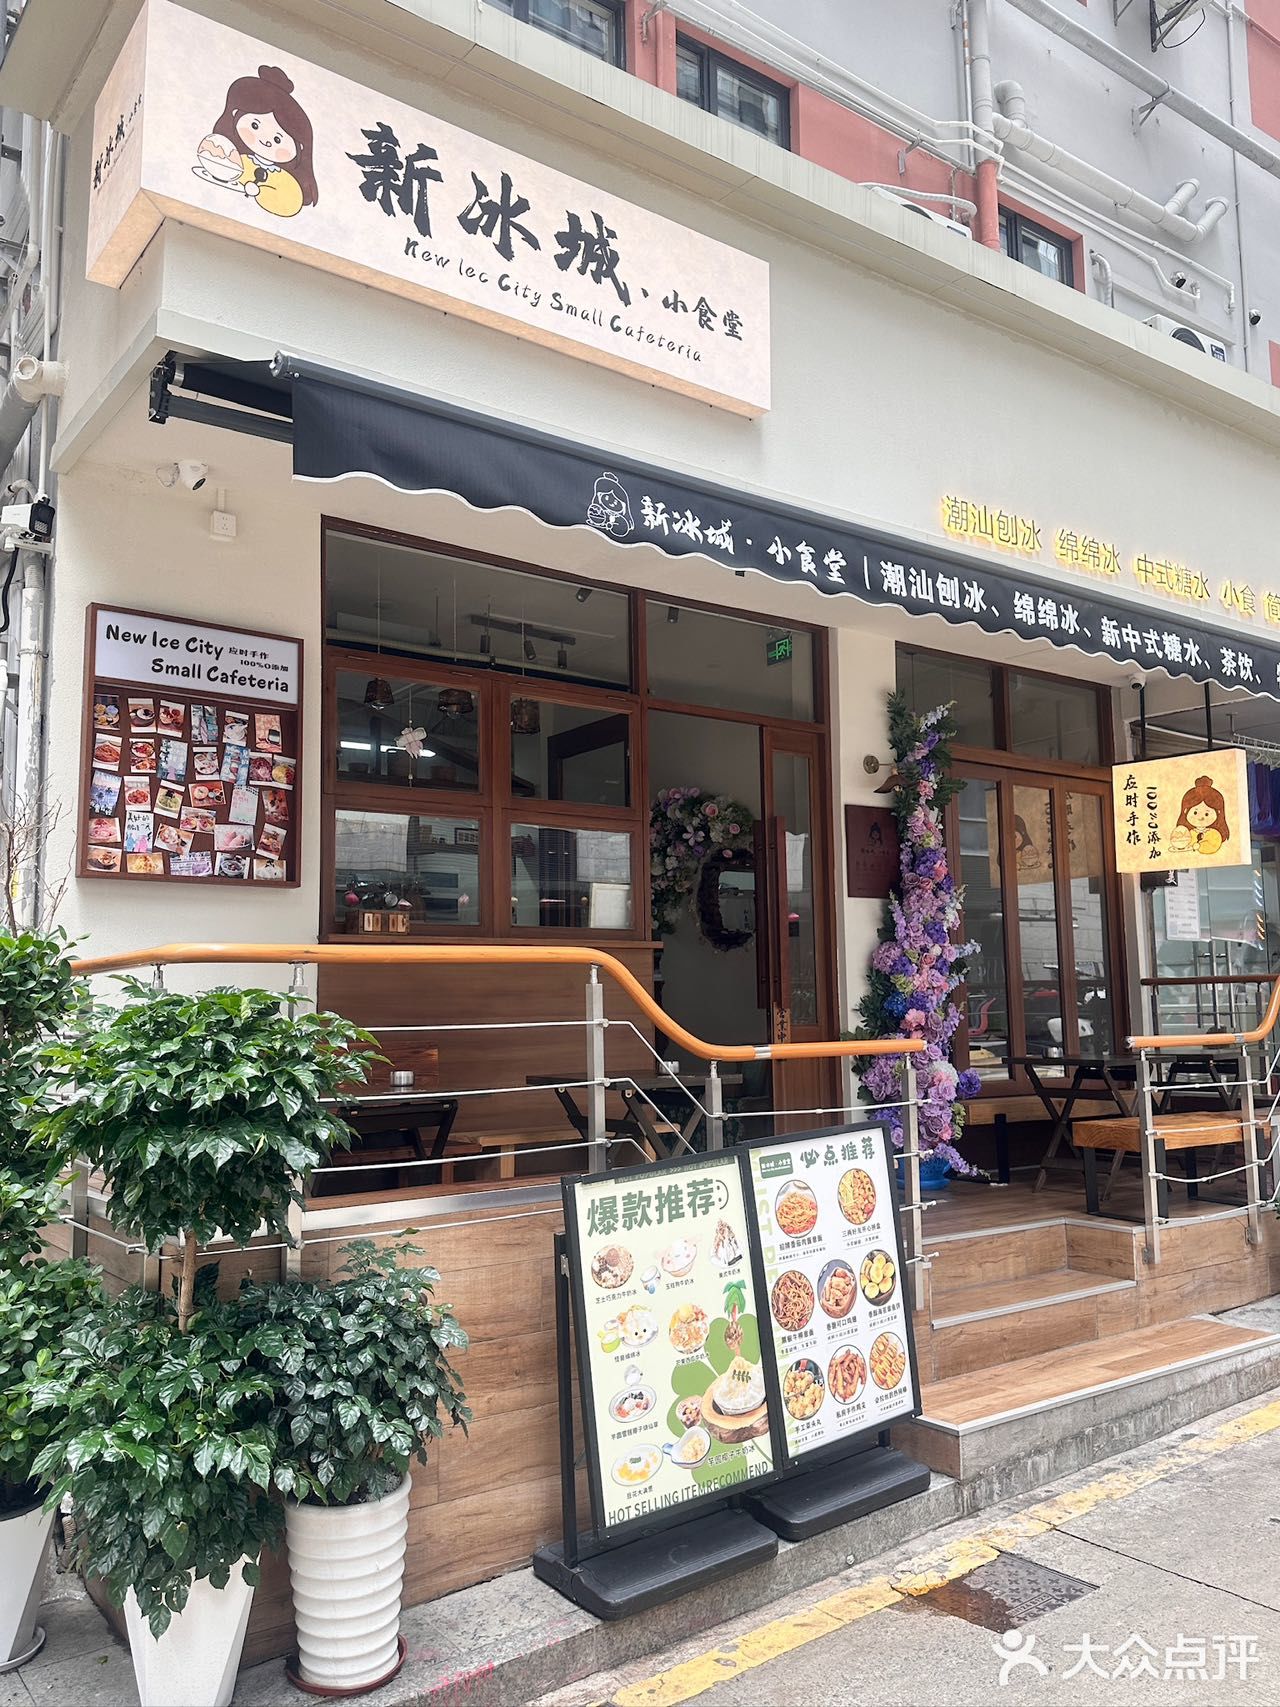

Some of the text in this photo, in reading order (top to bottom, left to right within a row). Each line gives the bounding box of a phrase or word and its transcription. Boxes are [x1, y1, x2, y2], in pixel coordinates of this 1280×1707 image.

[498, 273, 542, 307] City
[550, 292, 602, 327] Small
[609, 315, 702, 362] Cafeteria
[943, 496, 1042, 553] 潮汕刨冰
[1056, 528, 1121, 575] 绵绵冰
[1135, 554, 1211, 601] 中式糖水
[1220, 580, 1256, 615] 小食
[105, 624, 224, 660] New Ice City
[151, 658, 289, 692] Small Cafeteria
[1123, 774, 1141, 846] 应时手作
[587, 1178, 716, 1237] 爆款推荐
[595, 1288, 638, 1304] 芝士巧克力牛奶冰
[608, 1506, 632, 1525] HOT
[634, 1492, 680, 1516] SELLING
